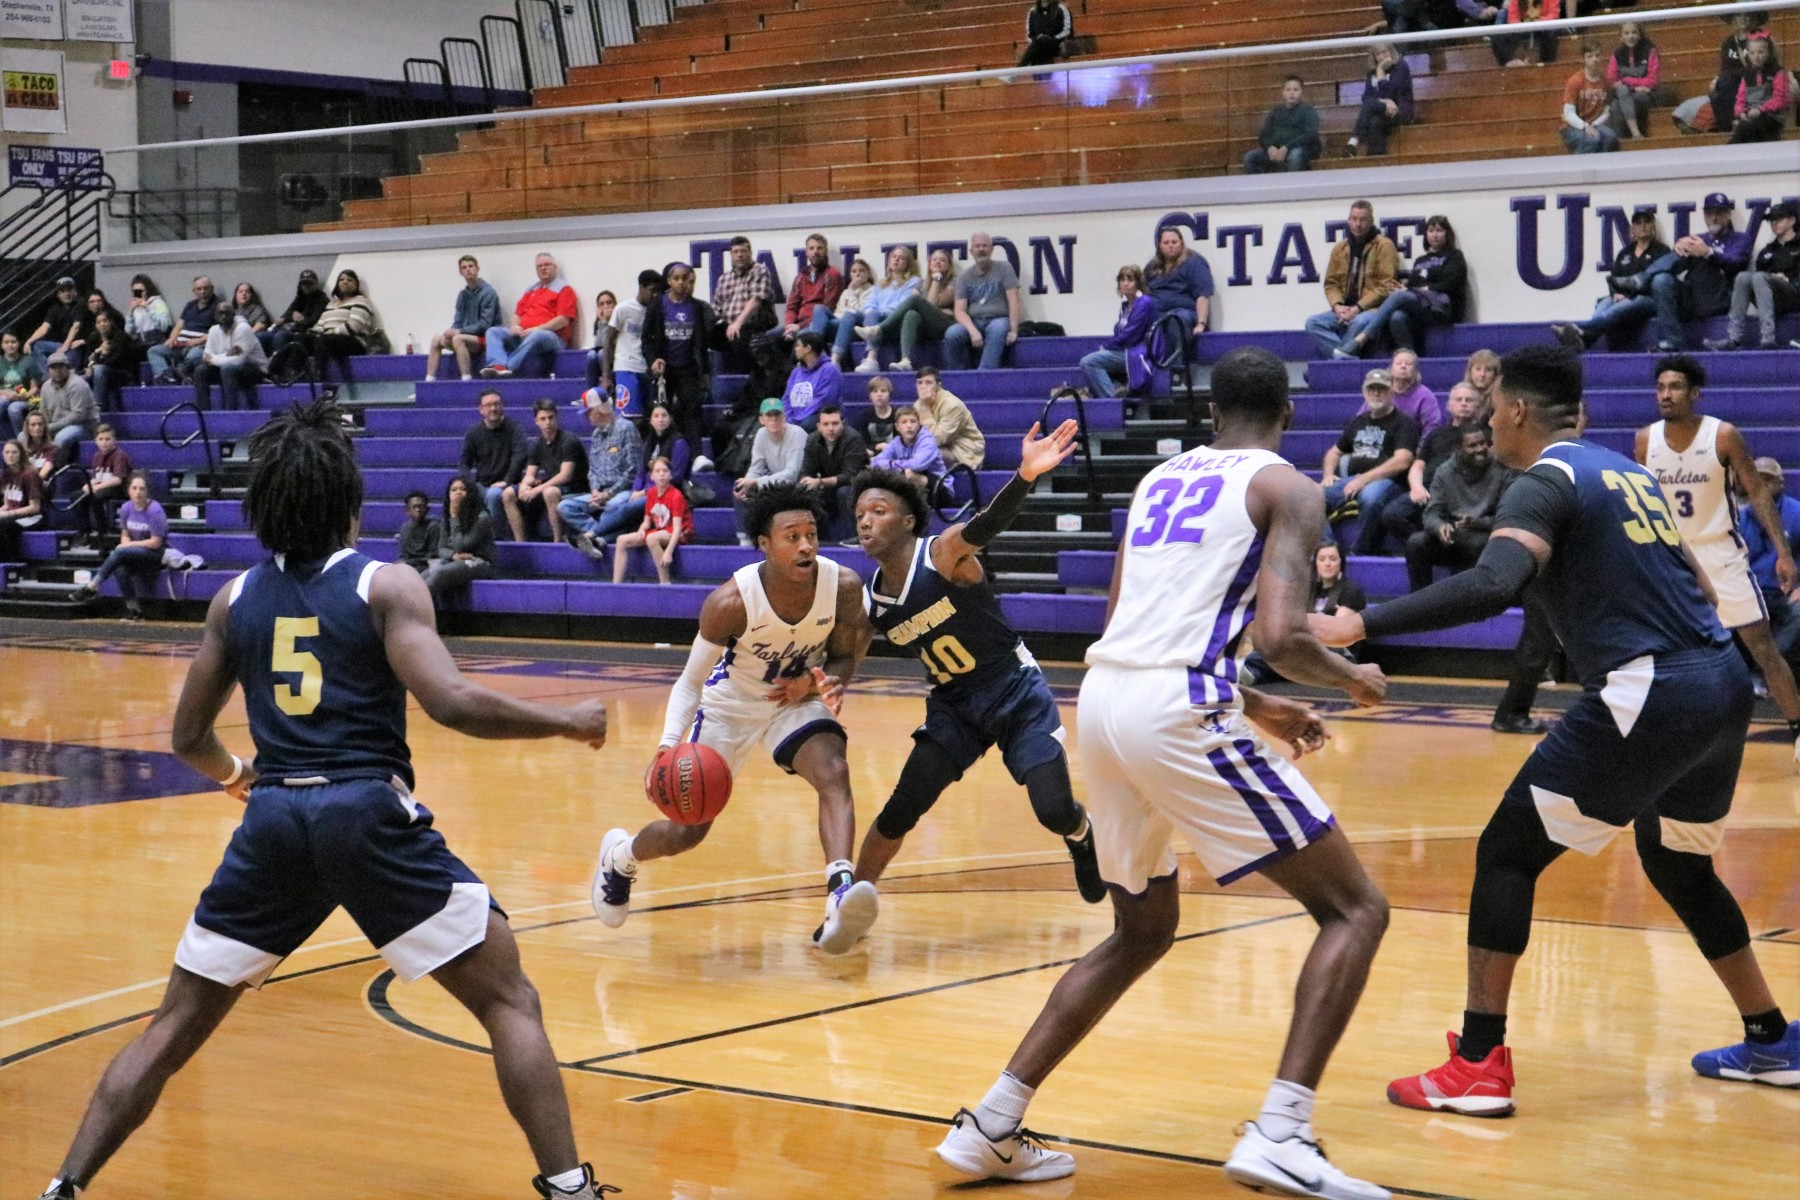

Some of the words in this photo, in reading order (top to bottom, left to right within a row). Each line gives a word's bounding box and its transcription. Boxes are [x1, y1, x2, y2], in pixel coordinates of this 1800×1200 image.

[21, 75, 55, 91] TACO
[21, 90, 57, 107] CASA
[11, 147, 30, 160] TSU
[31, 148, 55, 161] FANS
[57, 151, 76, 164] TSU
[21, 162, 46, 176] ONLY
[1161, 455, 1250, 473] HAWLEY
[1655, 468, 1711, 485] Tarleton
[1131, 474, 1224, 547] 32
[1601, 469, 1680, 546] 35
[1674, 490, 1695, 518] 3
[886, 595, 957, 646] CHAMPION
[271, 616, 323, 716] 5
[763, 654, 808, 684] 14
[920, 634, 976, 685] 10
[677, 756, 693, 813] Wilson
